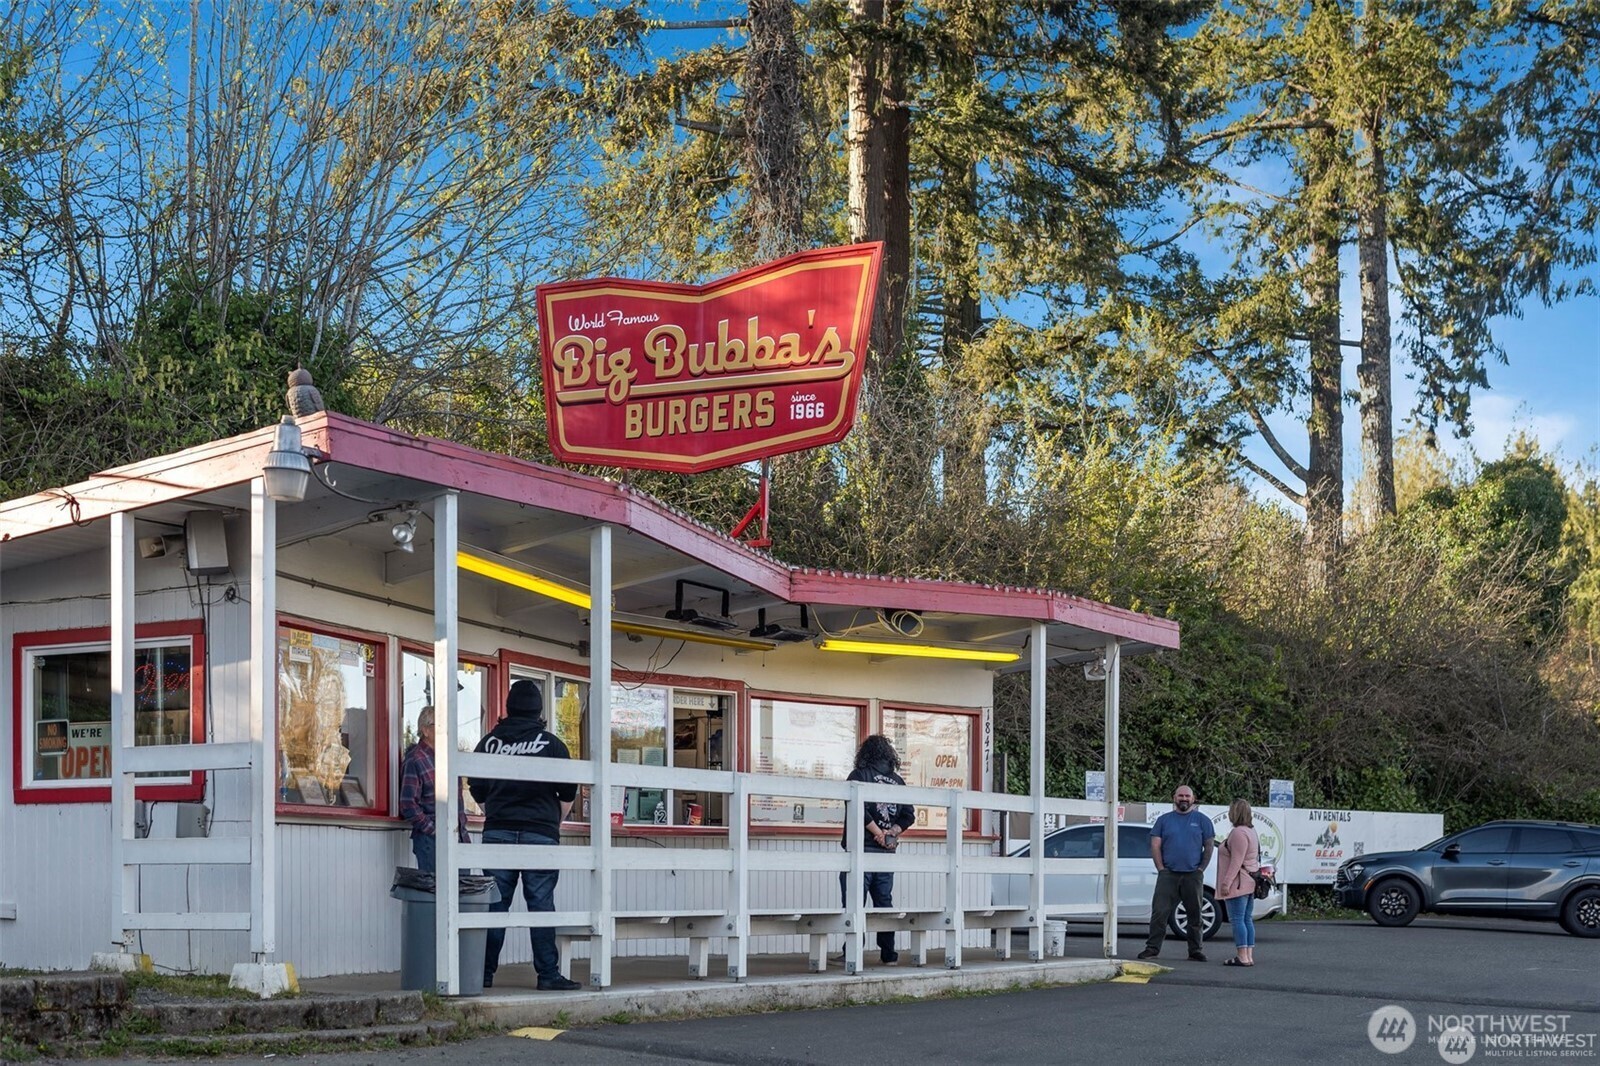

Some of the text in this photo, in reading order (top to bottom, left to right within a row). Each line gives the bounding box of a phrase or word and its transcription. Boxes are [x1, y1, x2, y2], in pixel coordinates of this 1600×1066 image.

[568, 310, 659, 331] World Famous
[553, 309, 854, 402] Big Bubba's
[790, 391, 816, 402] since
[625, 391, 775, 439] BURGERS
[789, 402, 824, 419] 1966
[673, 696, 704, 706] RDER HERE
[47, 723, 57, 736] NO
[71, 728, 102, 738] WE'RE
[39, 736, 67, 749] SMOKING
[485, 733, 550, 755] Donut
[62, 745, 111, 779] OPEN
[935, 755, 959, 768] OPEN
[1253, 813, 1273, 828] REPAIR
[1309, 811, 1351, 822] ATV RENTALS
[1259, 833, 1276, 850] Guy
